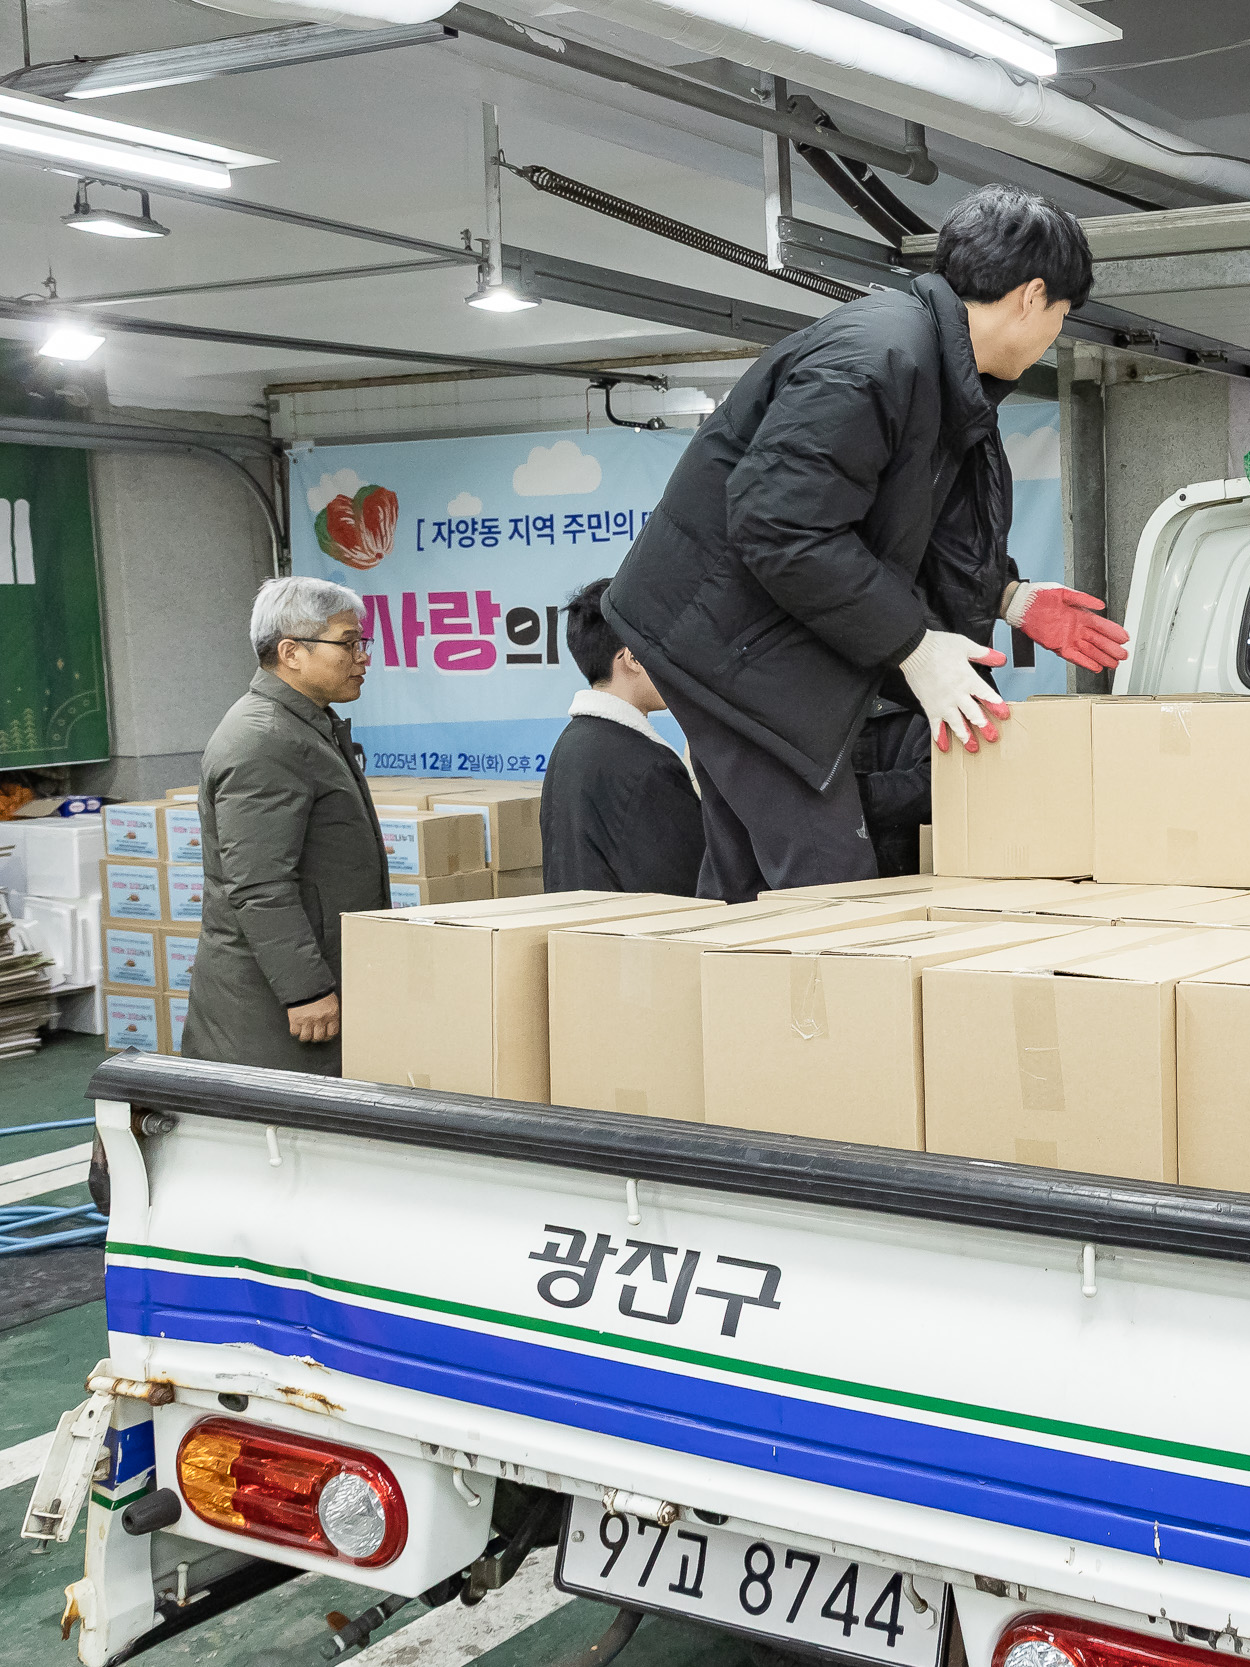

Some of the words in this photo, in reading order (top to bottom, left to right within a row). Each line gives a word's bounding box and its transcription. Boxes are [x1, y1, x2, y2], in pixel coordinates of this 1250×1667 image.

[432, 517, 502, 550] 자양동
[508, 514, 555, 546] 지역
[562, 509, 634, 545] 주민의
[361, 590, 560, 672] 사랑의
[373, 752, 417, 770] 2025년
[420, 752, 453, 772] 12월
[457, 752, 504, 773] 2일(화)
[506, 755, 532, 773] 오후
[528, 1223, 782, 1338] 광진구
[599, 1511, 708, 1599] 97고
[738, 1541, 905, 1648] 8744
